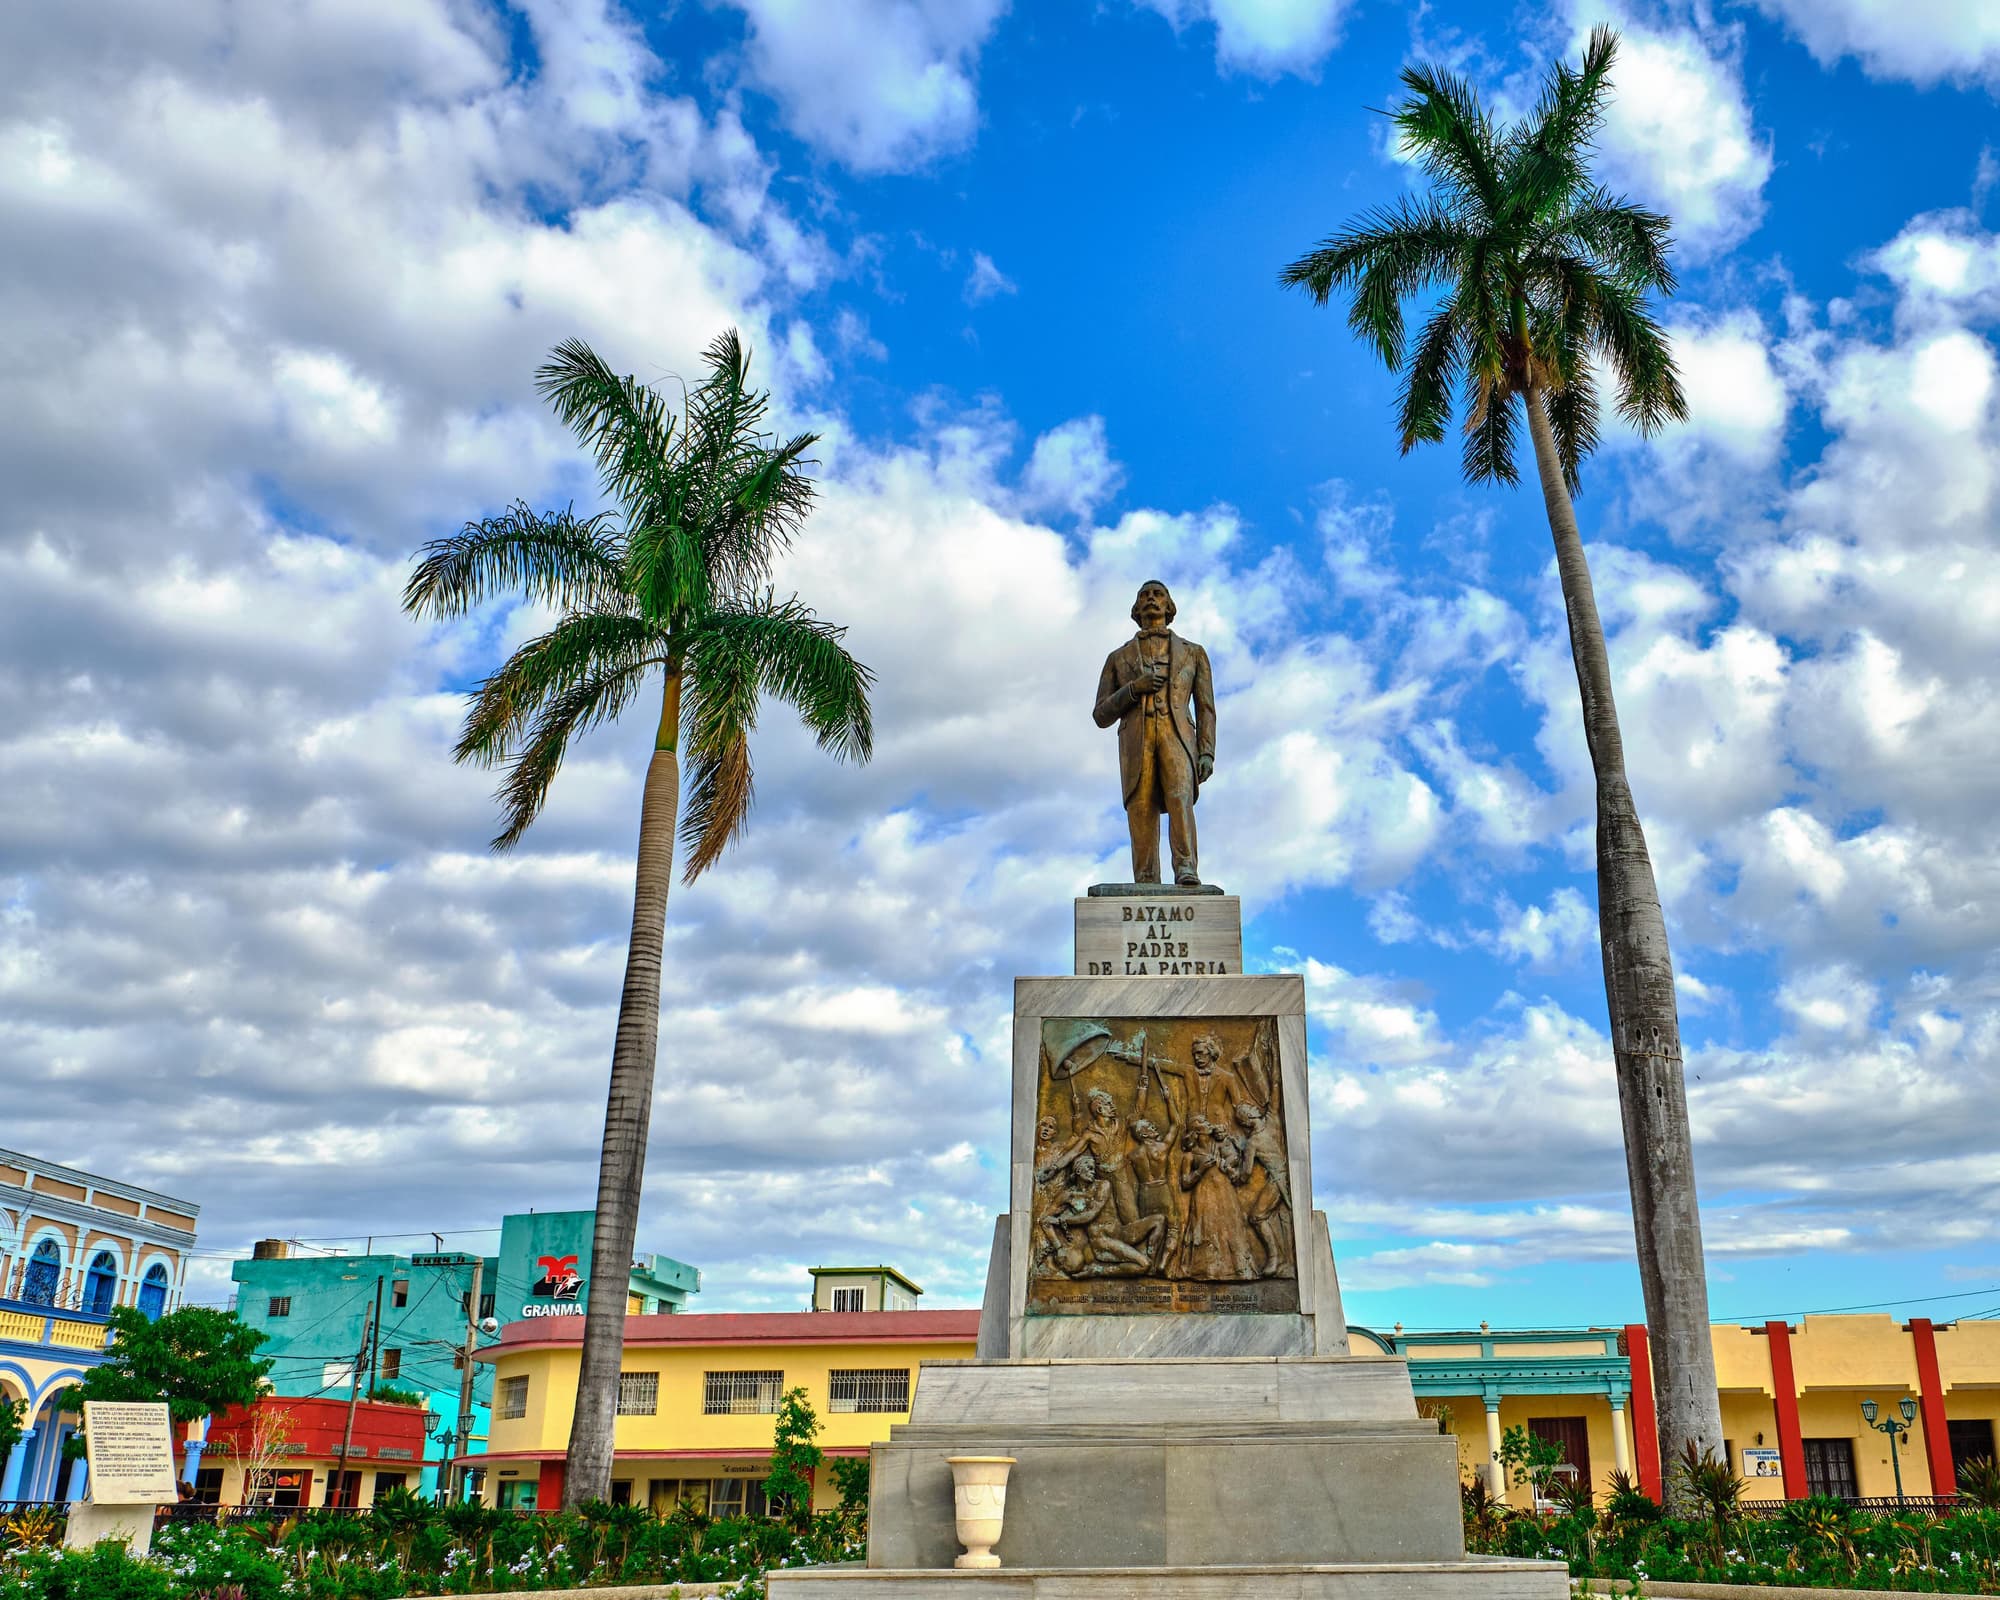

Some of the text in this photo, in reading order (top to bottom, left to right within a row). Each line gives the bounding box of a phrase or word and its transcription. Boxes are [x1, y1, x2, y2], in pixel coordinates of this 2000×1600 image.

[1122, 906, 1195, 922] BAYAMO
[1146, 924, 1172, 940] AL
[1127, 942, 1189, 958] PADRE
[1088, 961, 1227, 975] DE LA PATRIA
[522, 1303, 584, 1317] GRANMA
